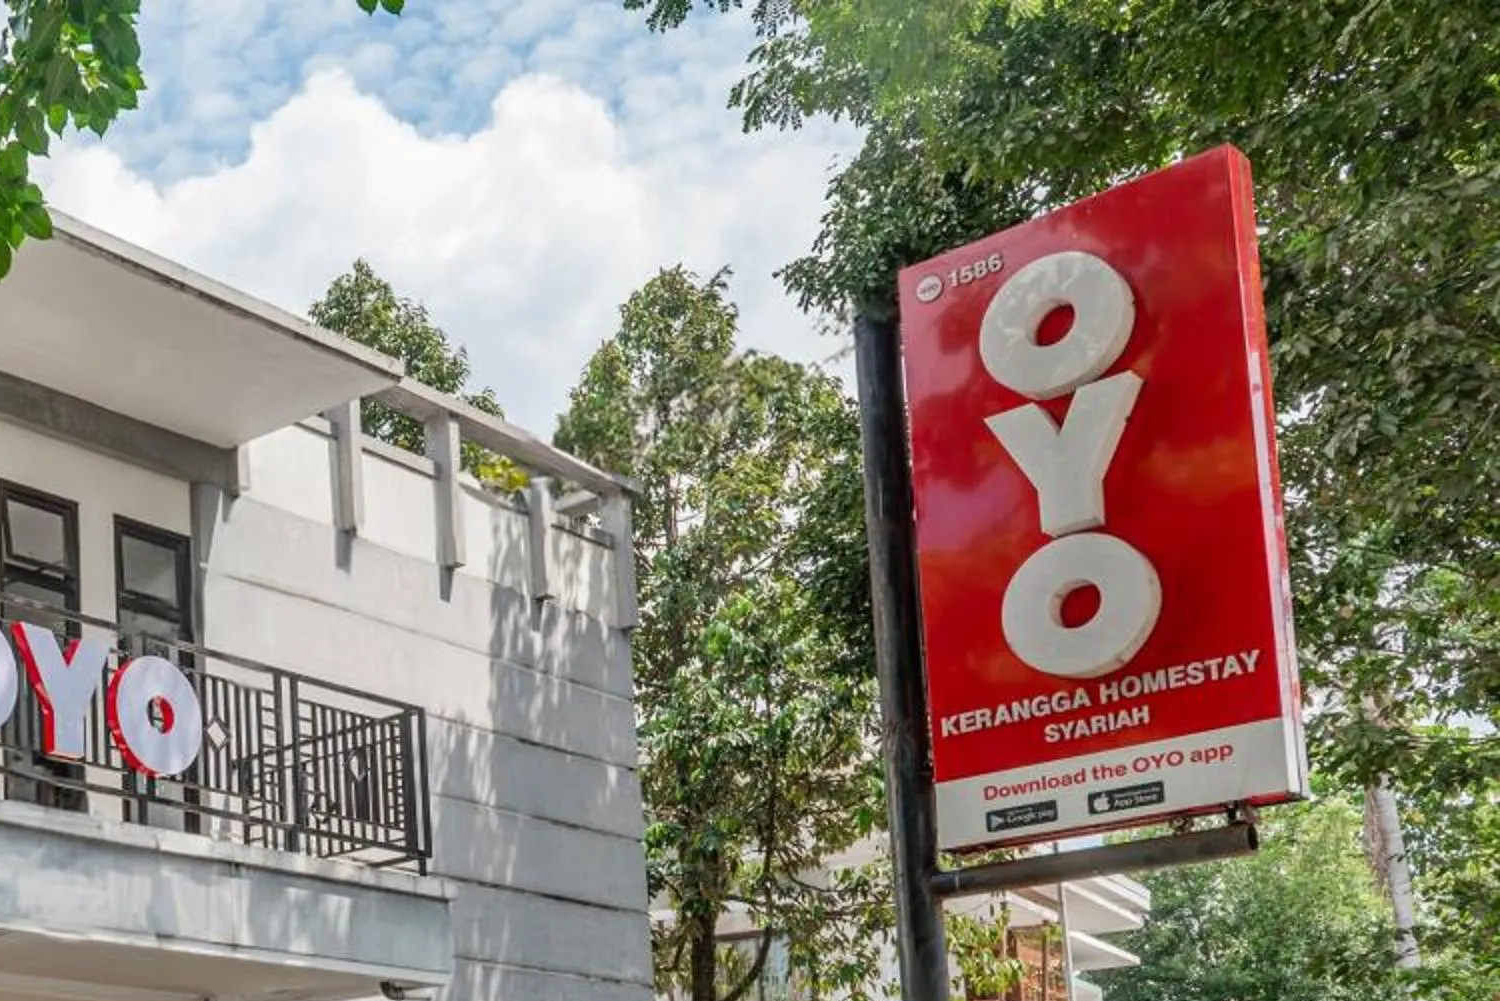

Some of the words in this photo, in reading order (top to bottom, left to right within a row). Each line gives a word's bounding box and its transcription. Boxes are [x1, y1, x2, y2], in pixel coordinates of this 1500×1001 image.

[979, 251, 1162, 680] OYO
[940, 686, 1092, 738] KERANGGA
[1099, 649, 1262, 703] HOMESTAY
[1043, 704, 1151, 744] SYARIAH
[983, 768, 1087, 801] Download
[1091, 762, 1127, 782] the
[1131, 750, 1184, 774] OYO
[1189, 743, 1234, 765] app
